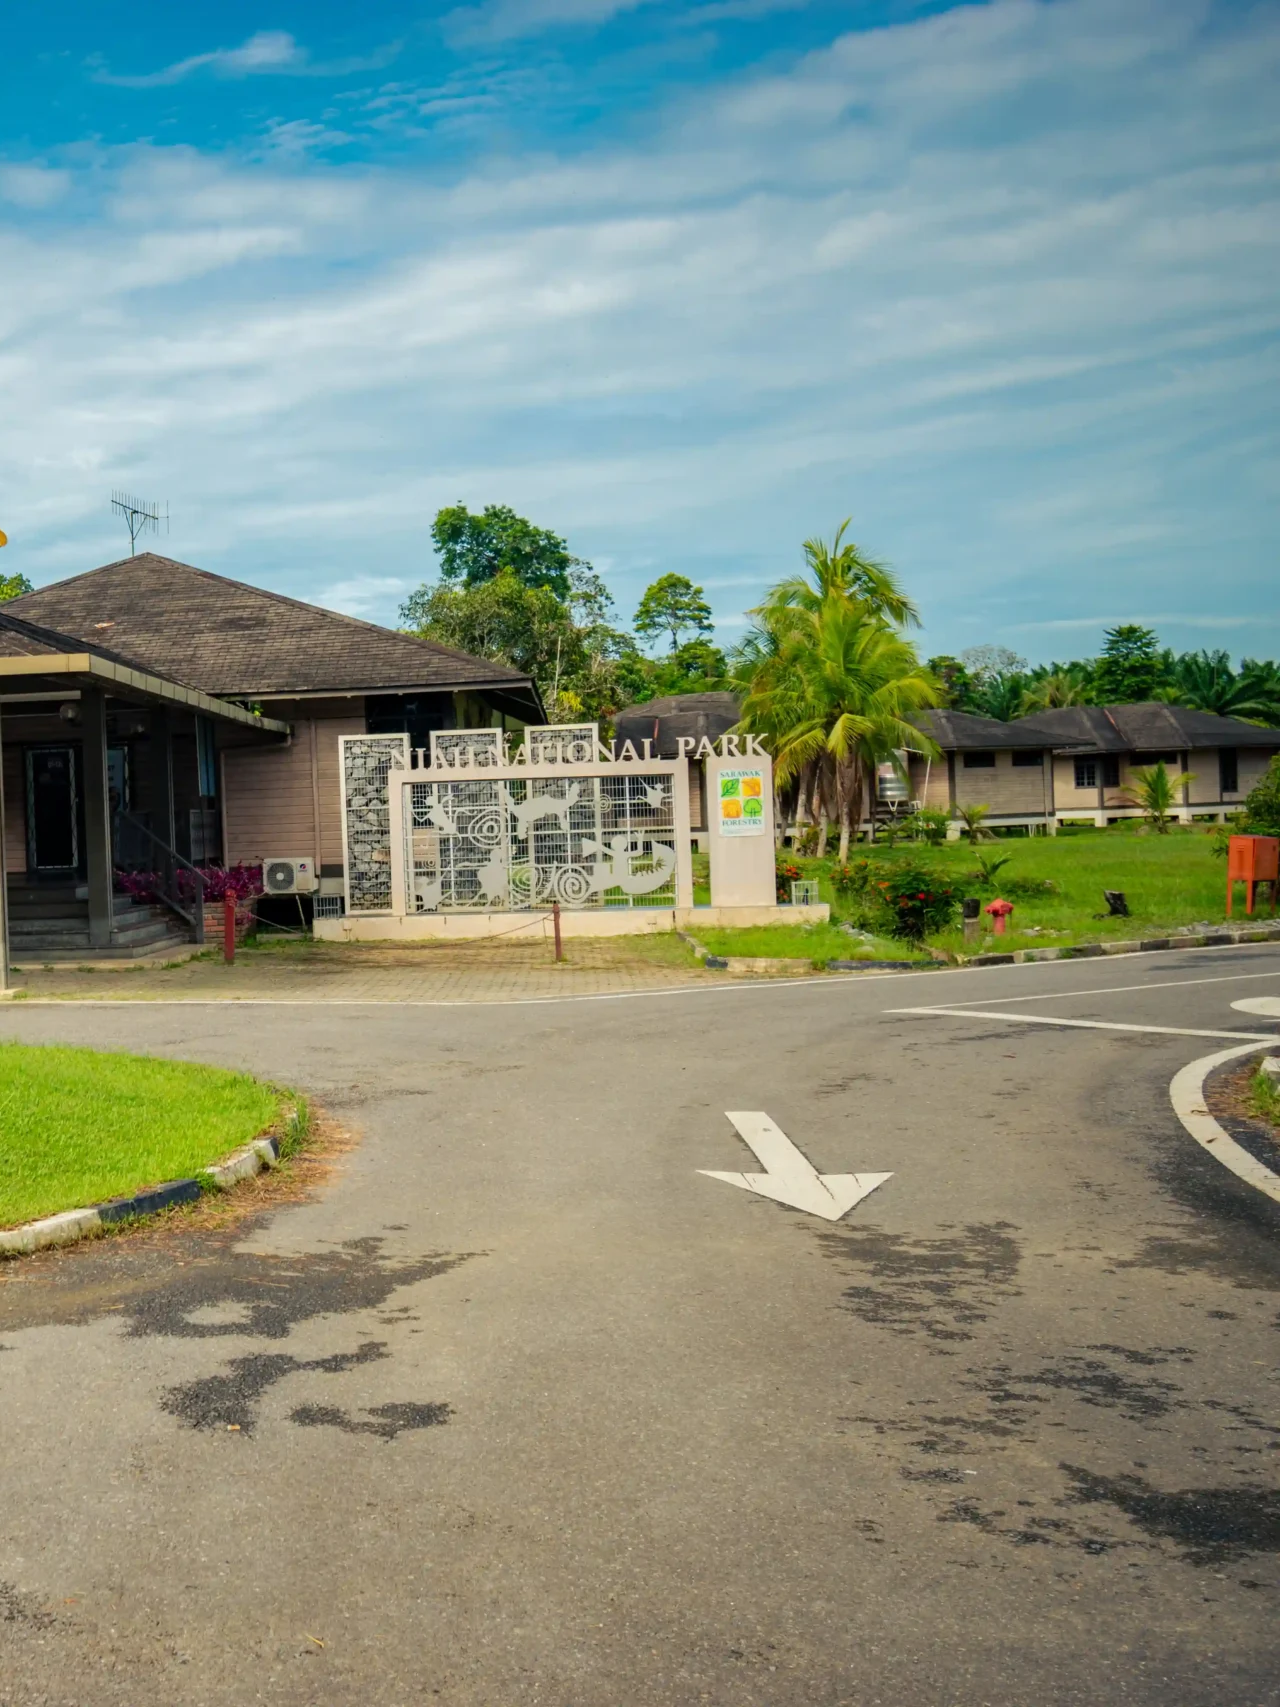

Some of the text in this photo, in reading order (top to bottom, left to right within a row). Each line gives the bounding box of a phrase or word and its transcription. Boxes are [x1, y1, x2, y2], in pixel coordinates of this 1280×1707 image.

[389, 733, 771, 770] NIAH NATIONAL PARK
[720, 770, 761, 778] SARAWAK
[721, 819, 762, 827] FORESTRY
